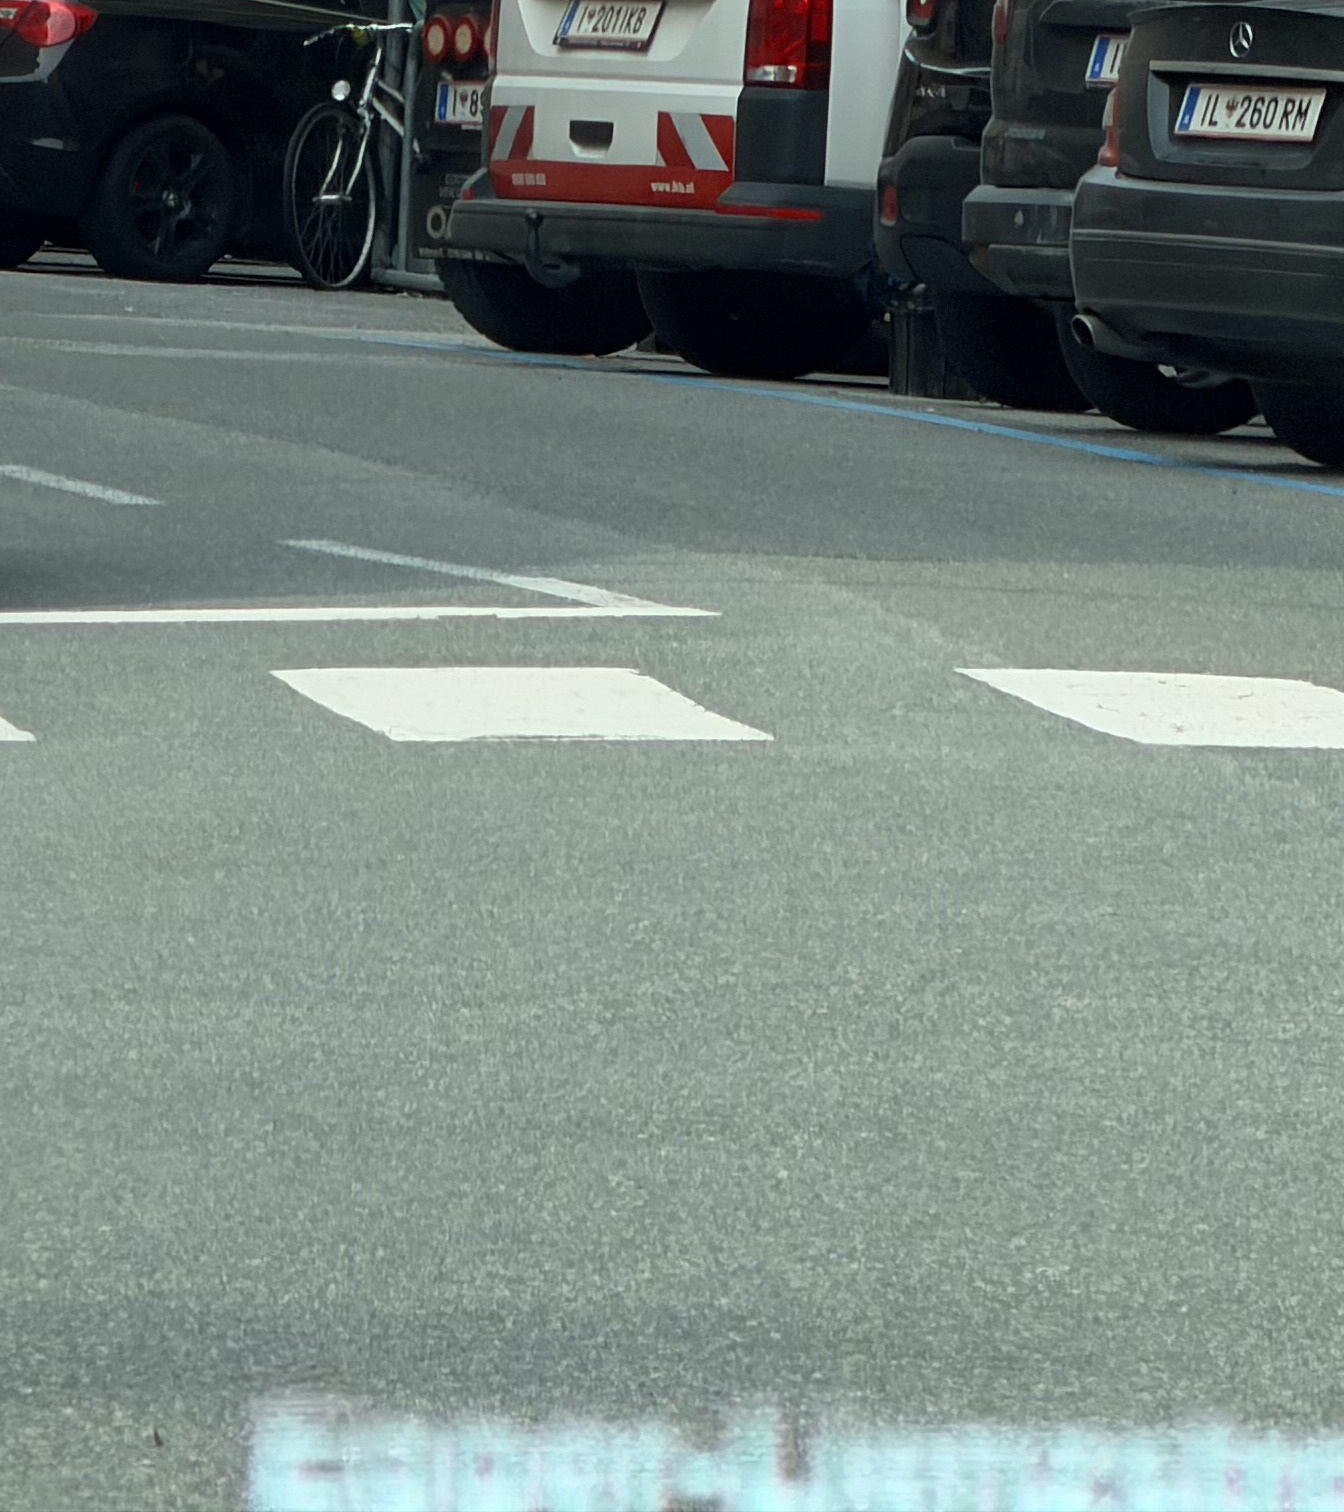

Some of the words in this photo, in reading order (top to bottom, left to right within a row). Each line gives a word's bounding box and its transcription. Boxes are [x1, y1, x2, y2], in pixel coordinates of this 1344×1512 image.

[1200, 94, 1219, 126] IL
[1235, 95, 1278, 129] 260
[1278, 98, 1312, 131] RM
